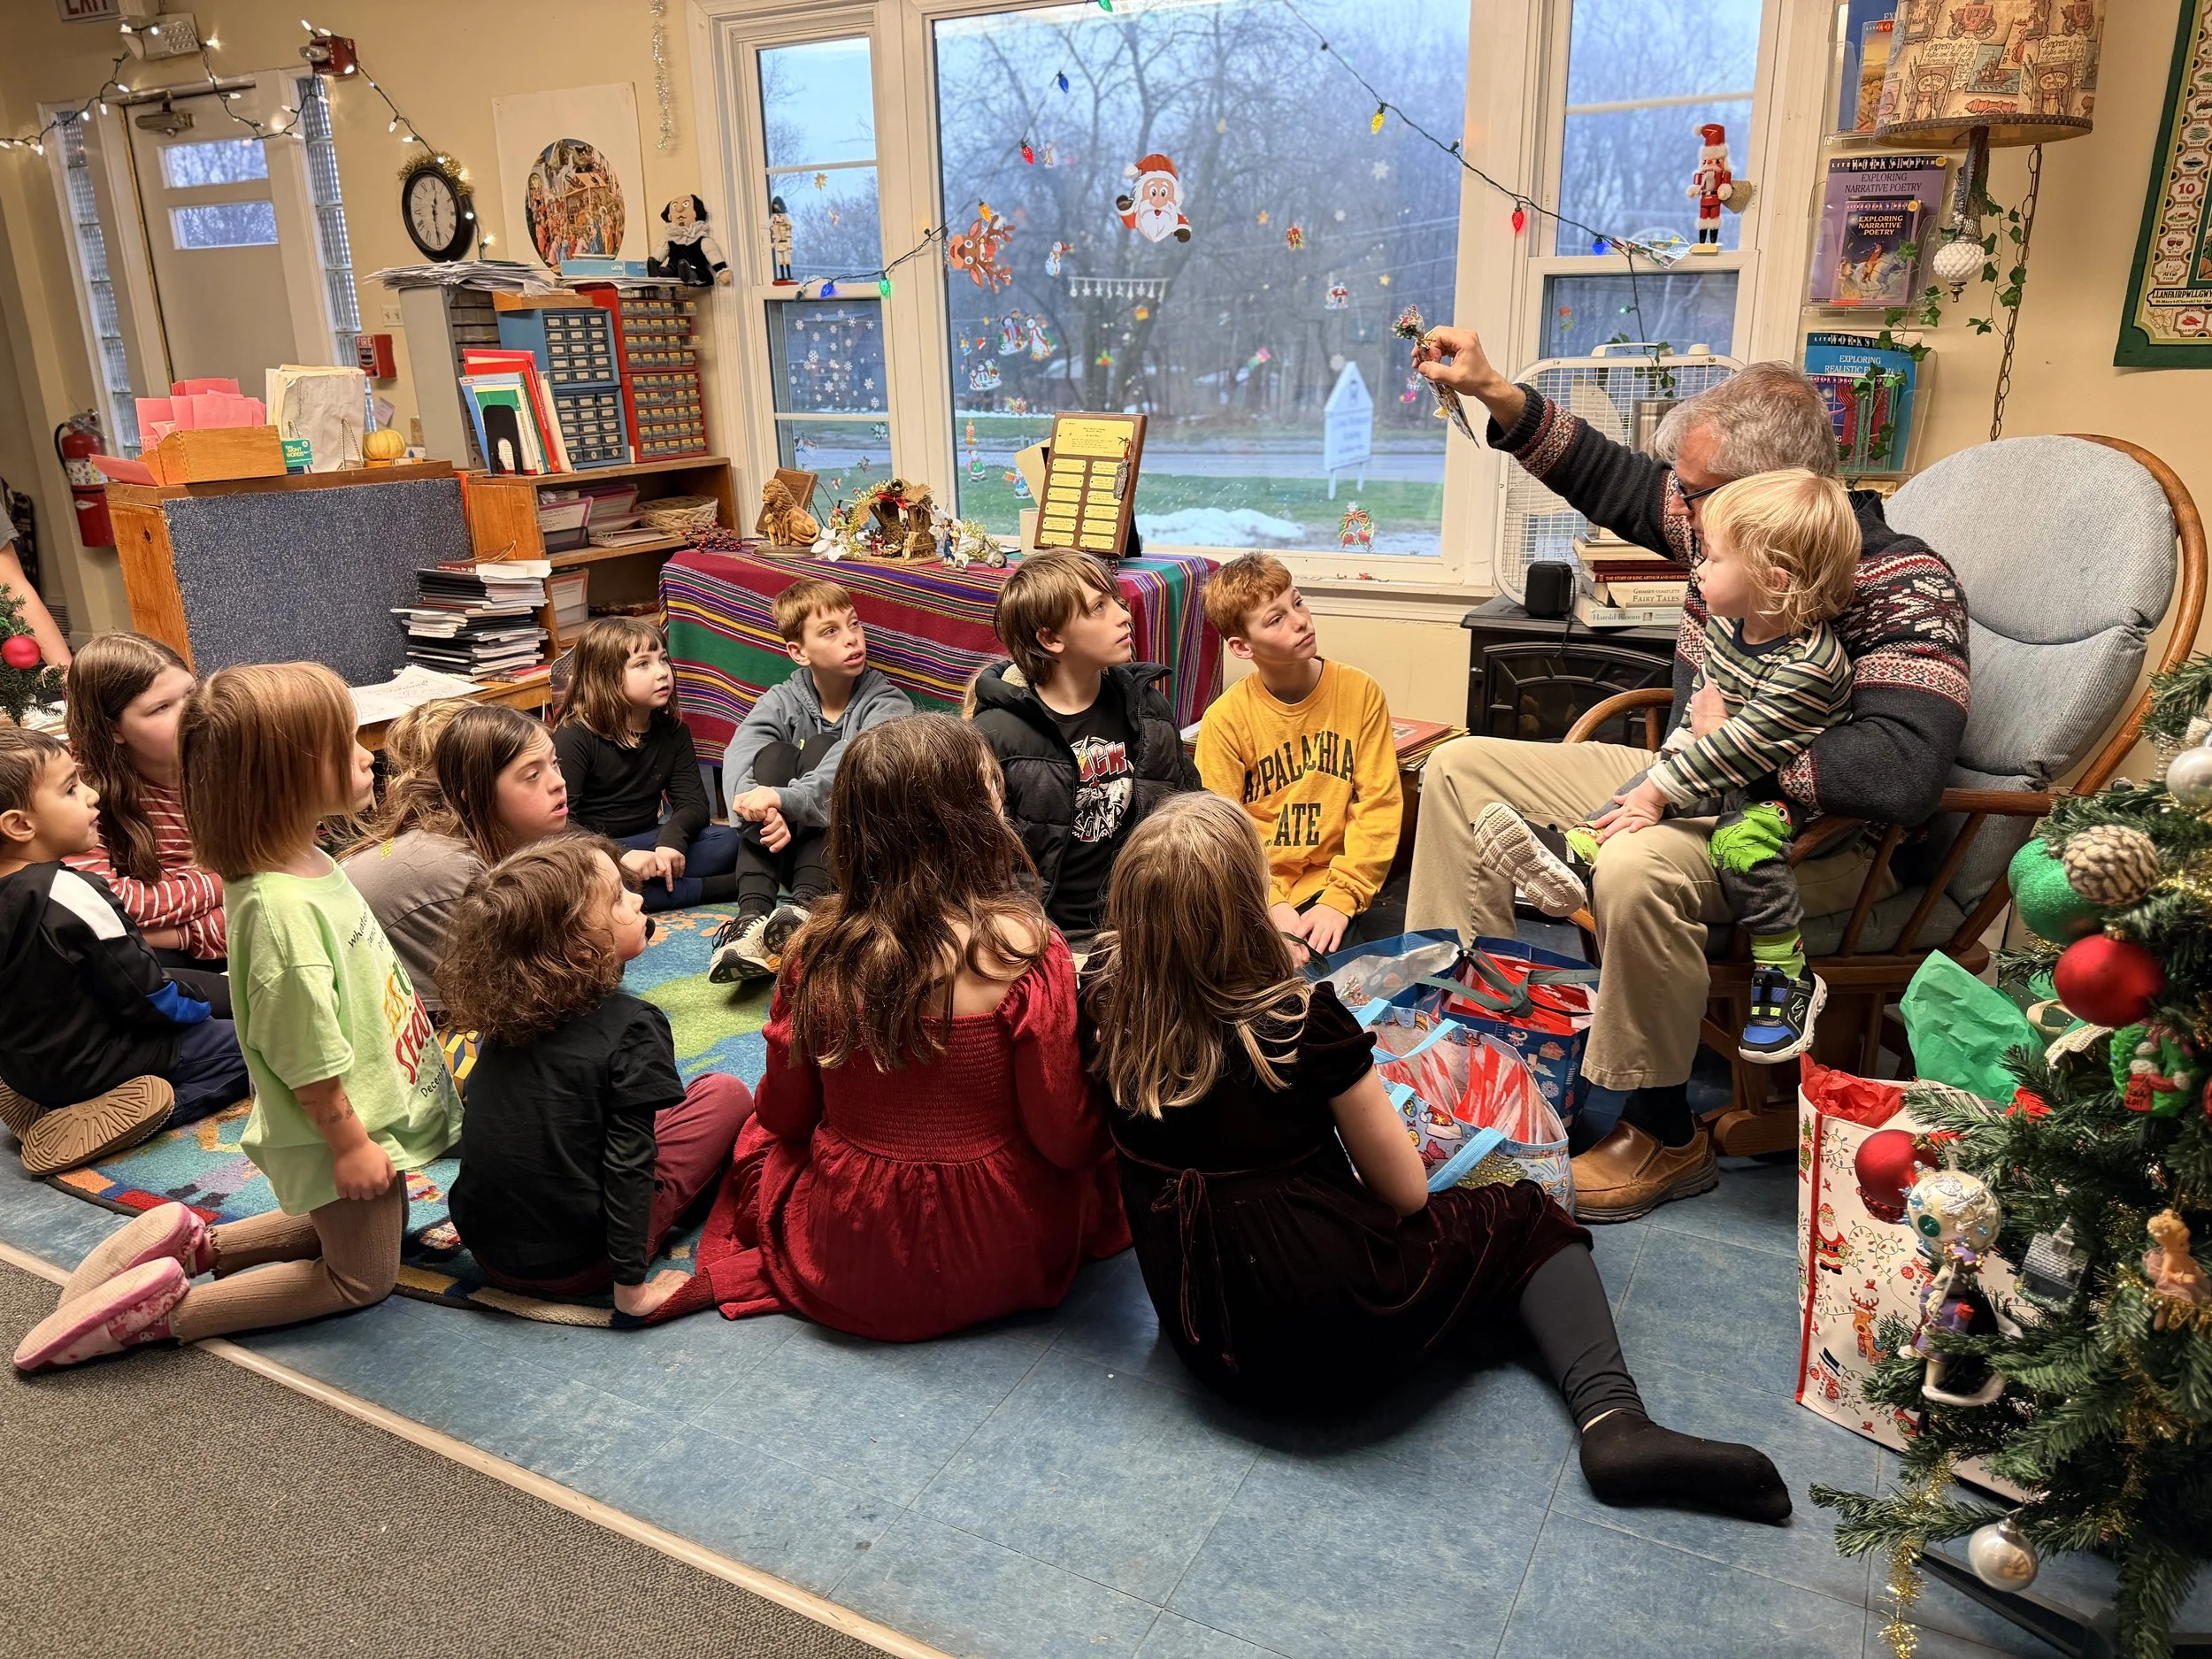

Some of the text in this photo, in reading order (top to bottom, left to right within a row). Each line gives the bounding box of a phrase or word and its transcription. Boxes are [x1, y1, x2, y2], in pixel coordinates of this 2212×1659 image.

[1861, 173, 1908, 182] EXPLORING
[1845, 182, 1923, 193] NARRATIVE POETRY
[2178, 182, 2195, 194] 10
[357, 337, 373, 347] FIRE
[1839, 354, 1881, 365] EXPLORING
[1824, 365, 1863, 373] REALISTIC
[1072, 735, 1127, 782] OCK
[1273, 803, 1322, 847] ATE
